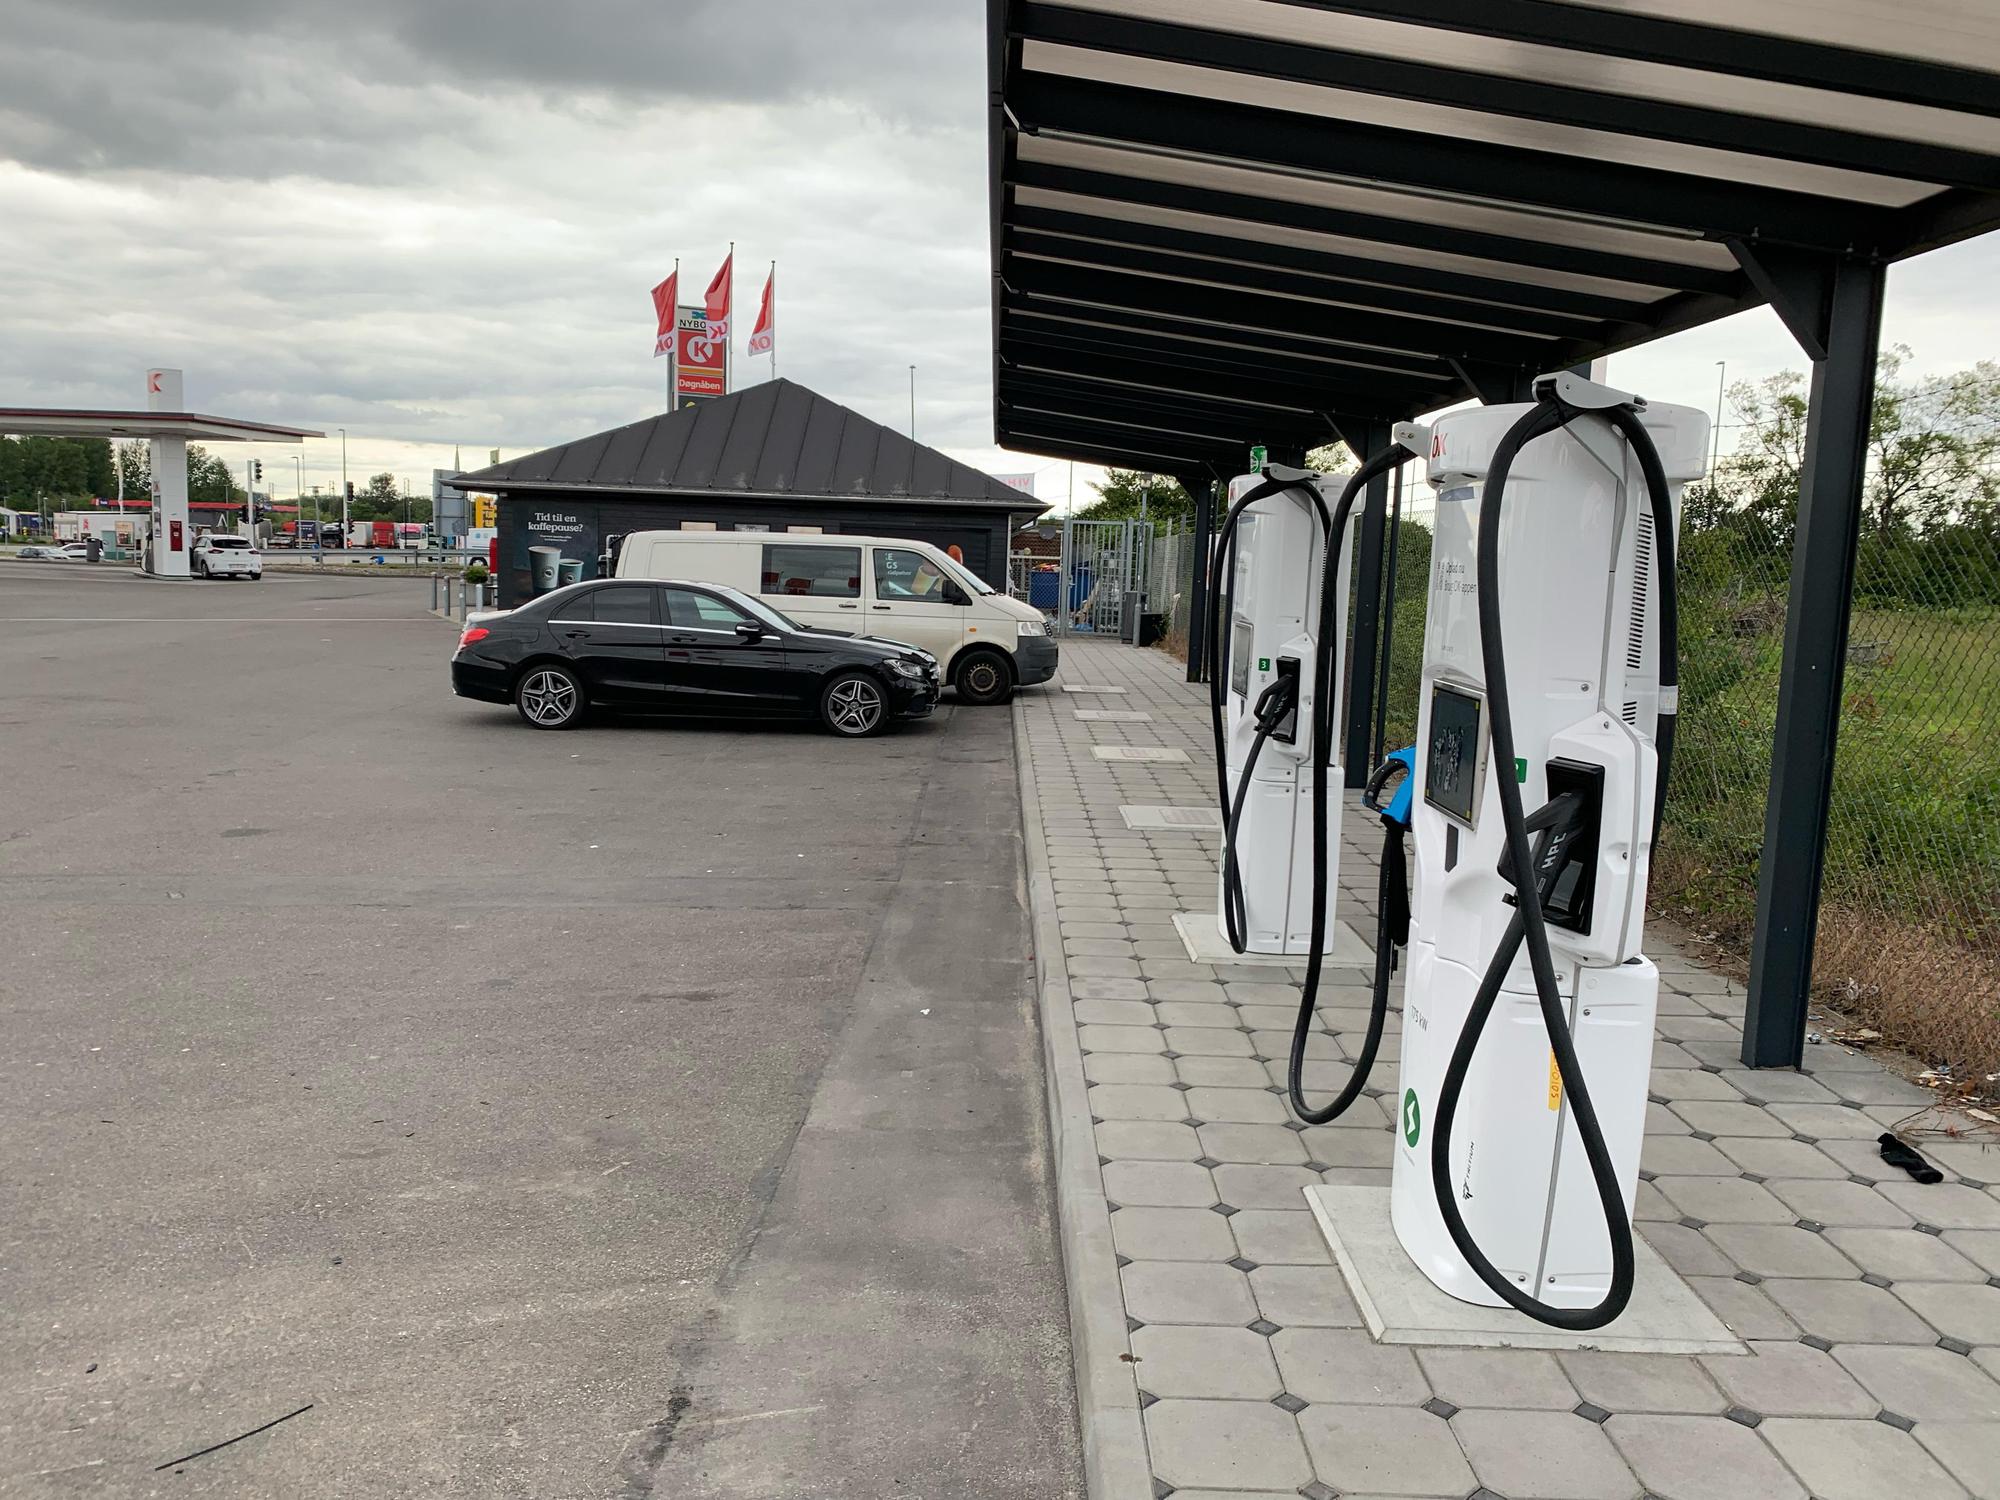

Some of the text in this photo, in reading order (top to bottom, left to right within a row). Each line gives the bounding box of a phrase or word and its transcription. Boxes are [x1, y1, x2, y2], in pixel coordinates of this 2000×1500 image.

[679, 319, 706, 330] NYBO
[679, 379, 721, 391] Døgnåben
[535, 513, 550, 521] Tid
[528, 522, 583, 533] kaffepause?
[1541, 832, 1567, 869] HPC
